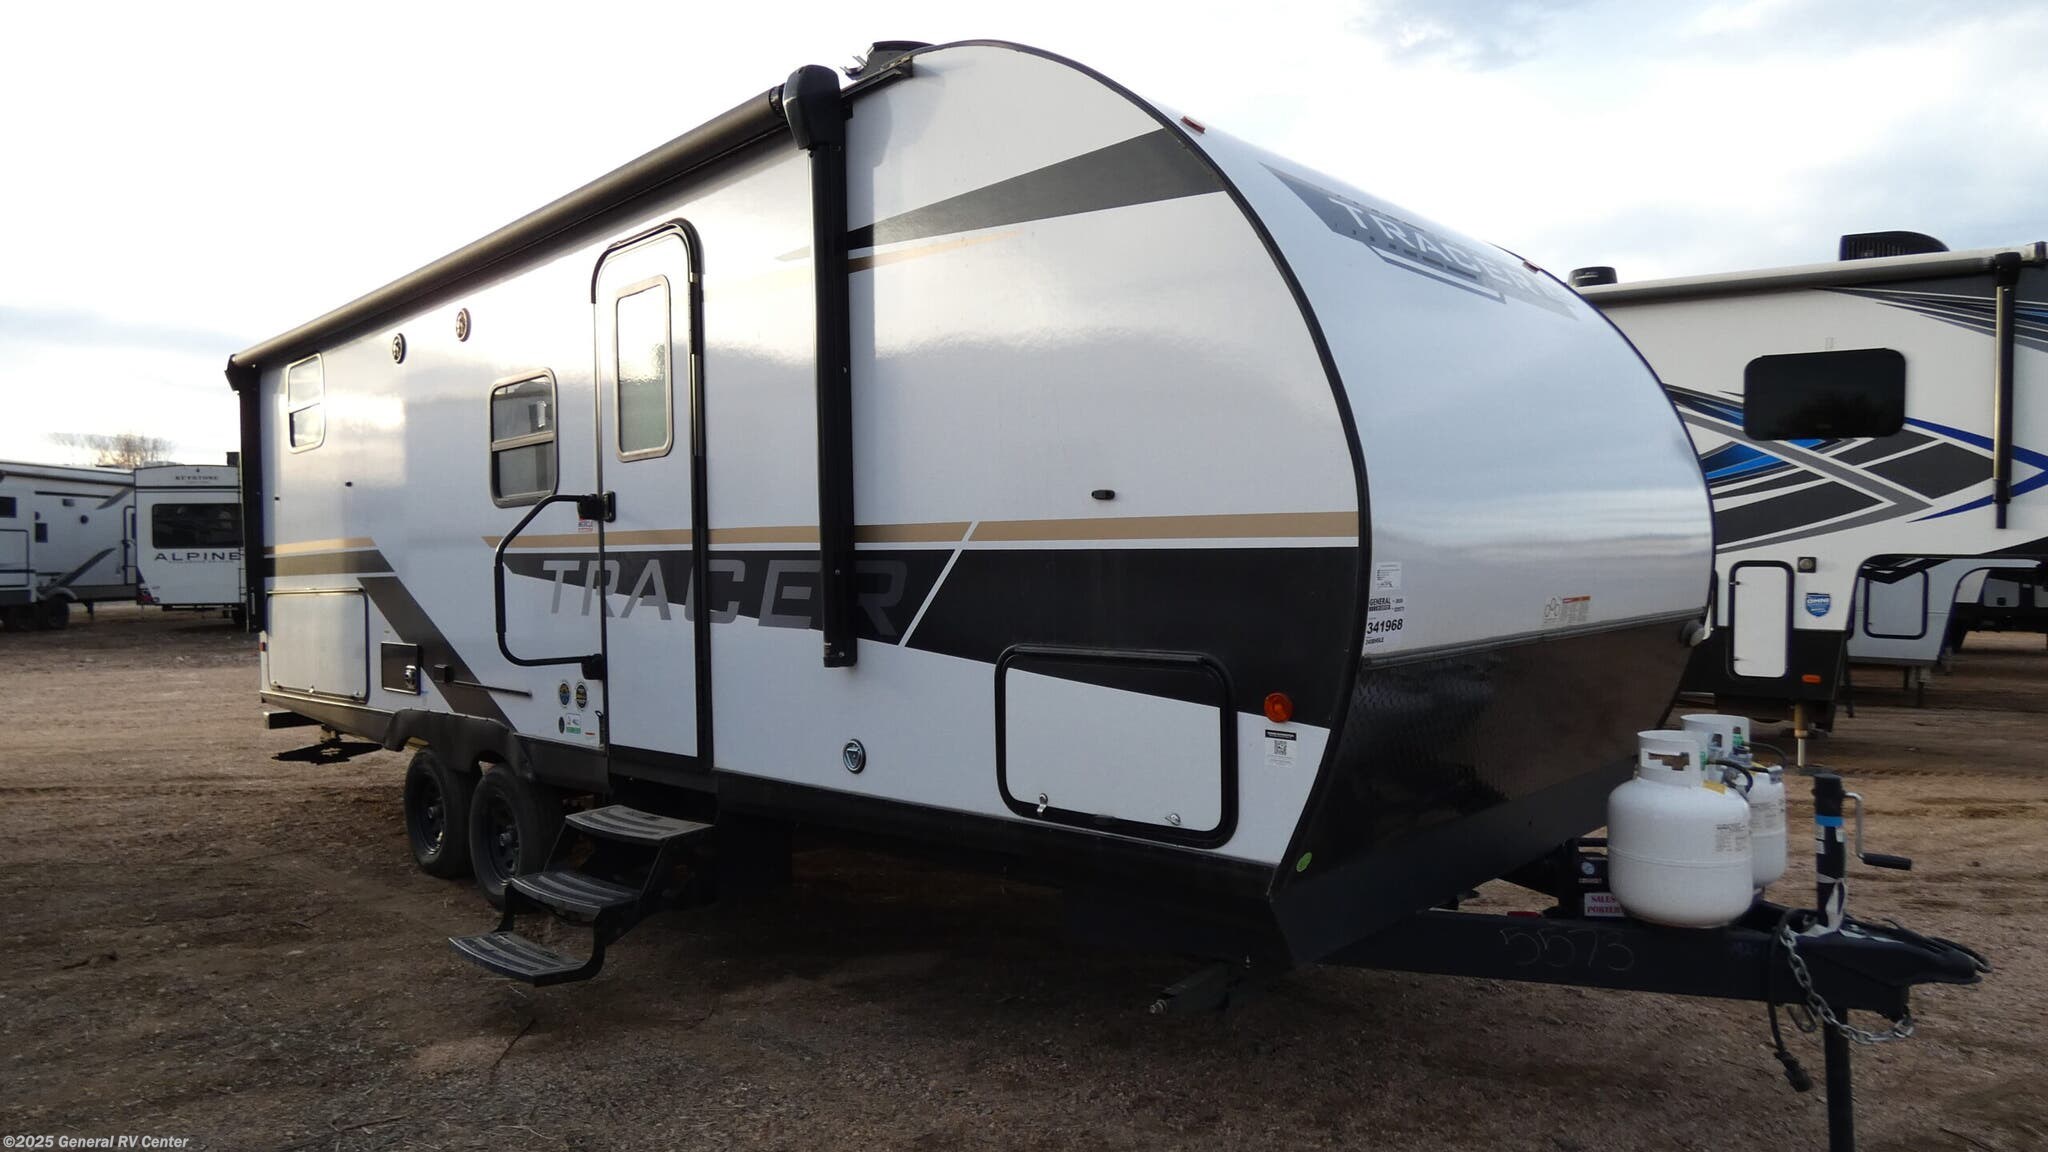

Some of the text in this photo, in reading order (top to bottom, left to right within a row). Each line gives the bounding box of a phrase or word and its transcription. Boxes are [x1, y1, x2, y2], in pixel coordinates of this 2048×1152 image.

[1328, 196, 1558, 299] TRACER
[154, 552, 242, 561] ALPINE
[541, 558, 908, 636] TRACER
[1367, 618, 1403, 634] 341968
